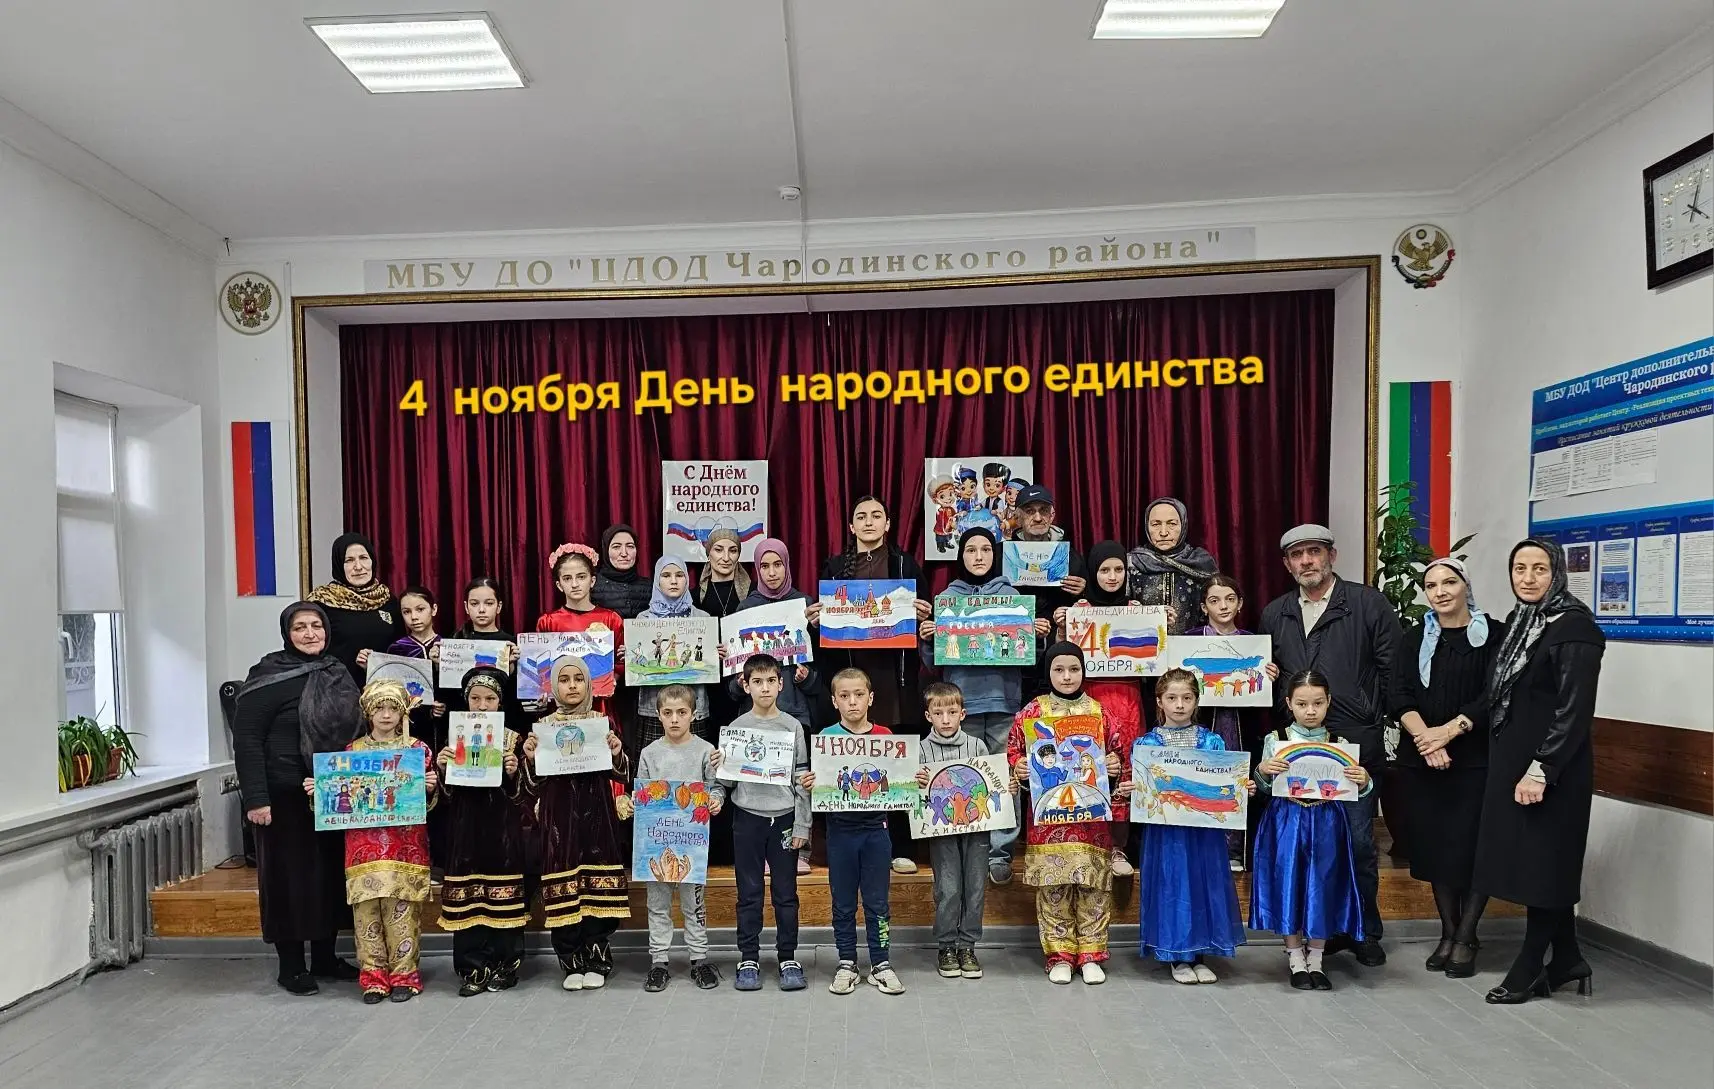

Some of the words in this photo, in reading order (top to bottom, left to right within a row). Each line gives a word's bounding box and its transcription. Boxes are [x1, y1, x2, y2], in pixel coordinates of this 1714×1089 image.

[387, 262, 475, 289] МБУ
[494, 259, 553, 288] ДО
[569, 255, 709, 284] "ЦДОД
[726, 247, 1027, 282] Чародинского
[1048, 231, 1221, 269] района"
[1624, 364, 1708, 395] Чародинского
[1545, 386, 1567, 403] МБУ
[1567, 380, 1591, 399] ДОД
[1660, 403, 1712, 421] деятельности
[684, 465, 695, 479] С
[700, 464, 747, 482] Днём
[671, 484, 759, 500] народного
[676, 498, 756, 513] единства!
[1079, 621, 1100, 657] 4
[1084, 660, 1132, 672] ОЯБРЯ
[815, 736, 826, 754] 4
[830, 736, 907, 758] НОЯБРЯ
[1057, 784, 1077, 813] 4
[656, 817, 685, 828] ДЕНЬ
[1044, 811, 1093, 824] НОЯБРЯ
